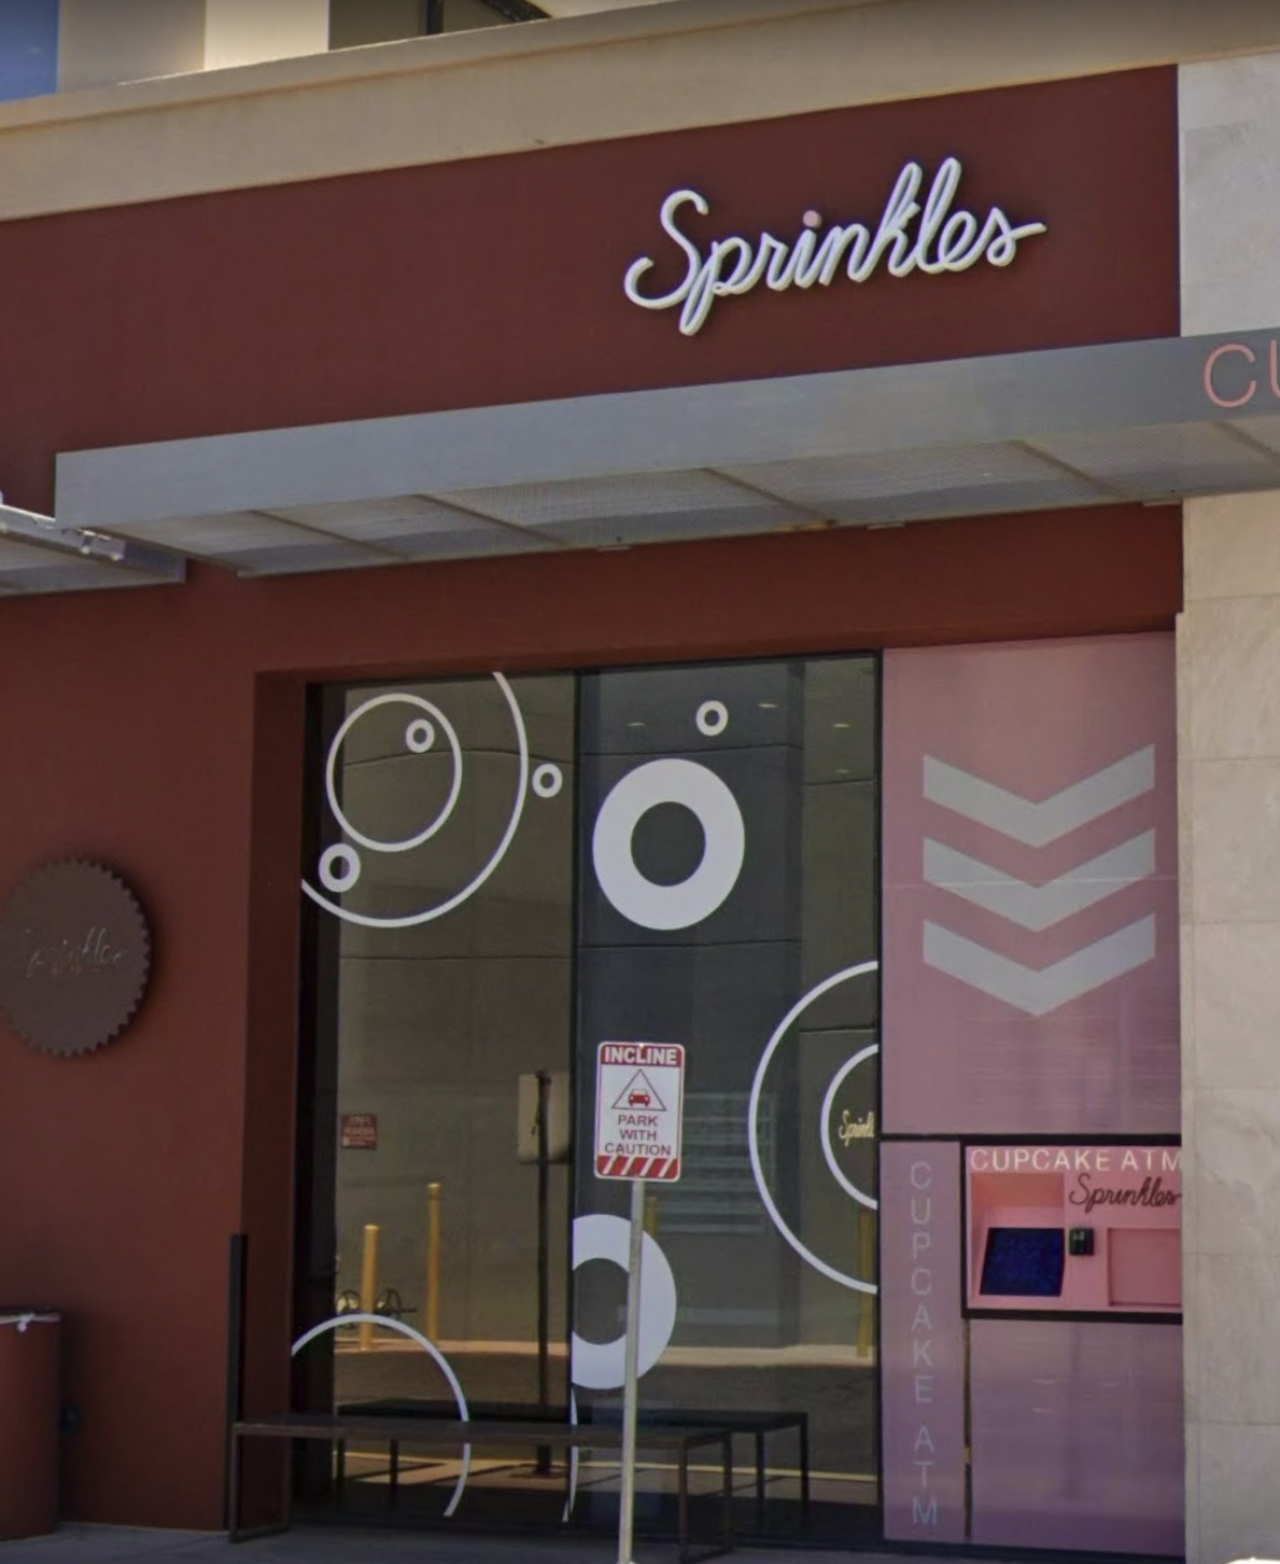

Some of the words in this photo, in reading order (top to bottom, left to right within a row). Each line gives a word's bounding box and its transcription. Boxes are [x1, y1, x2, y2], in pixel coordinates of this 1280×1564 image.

[624, 157, 1047, 335] Sprinkles
[604, 1046, 677, 1065] INCLINE
[618, 1115, 658, 1127] PARK
[620, 1129, 657, 1141] WITH
[604, 1142, 671, 1156] CAUTION
[970, 1149, 1111, 1172] CUPCAKE
[1121, 1149, 1182, 1172] ATM
[1069, 1172, 1182, 1214] Sprinkles
[909, 1162, 934, 1403] CUPCAKE
[912, 1425, 938, 1525] ATM
